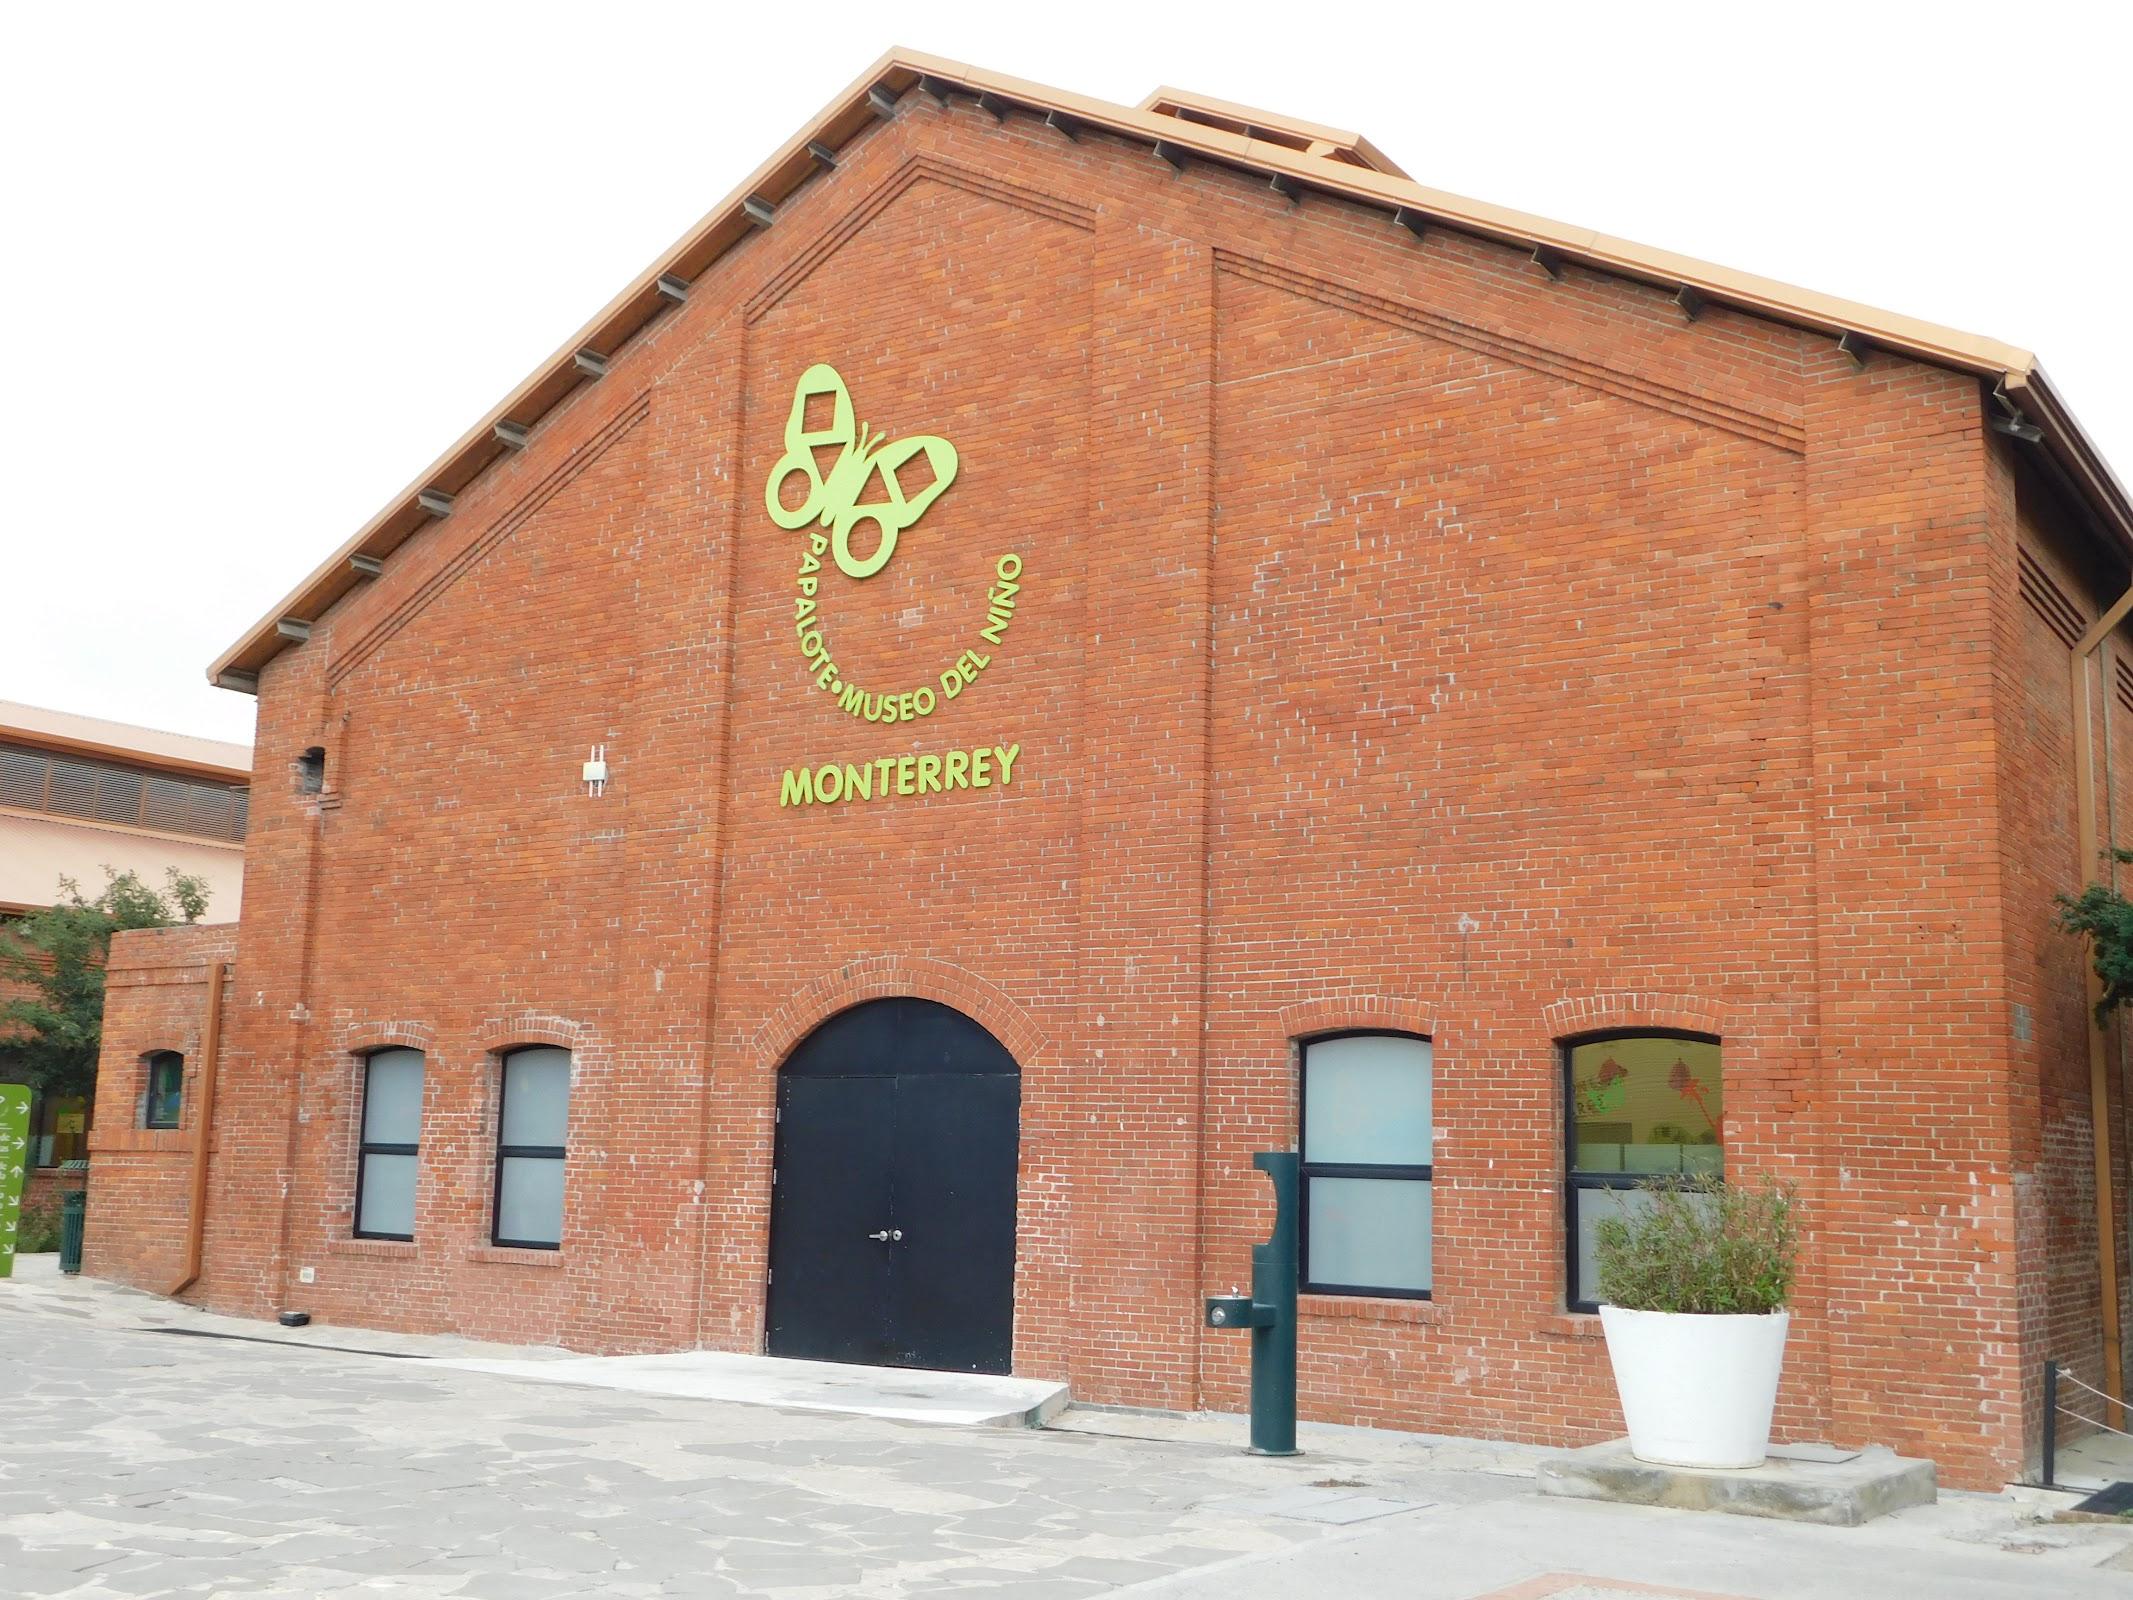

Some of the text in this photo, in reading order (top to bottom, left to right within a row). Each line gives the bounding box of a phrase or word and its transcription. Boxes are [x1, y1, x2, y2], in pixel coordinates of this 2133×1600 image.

[794, 533, 1023, 724] PAPALOTE MUSEO DEL NIÑO
[779, 743, 1021, 807] MONTERREY
